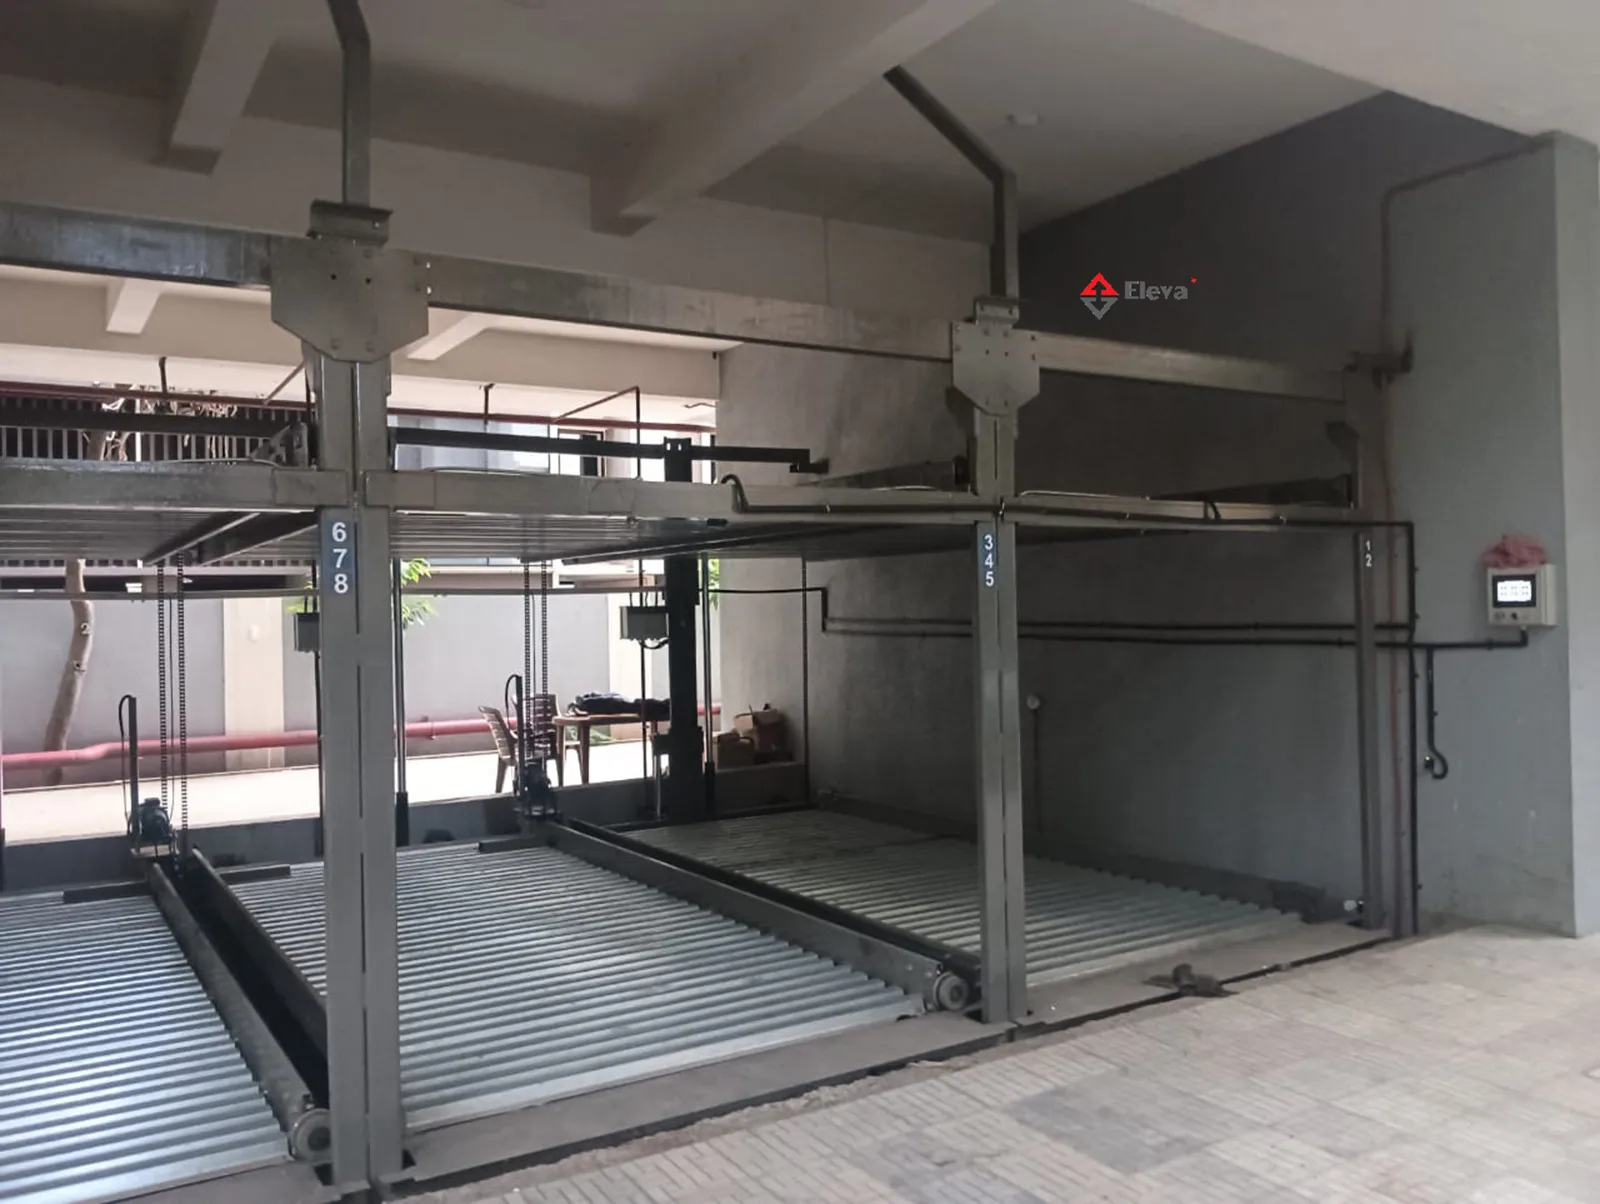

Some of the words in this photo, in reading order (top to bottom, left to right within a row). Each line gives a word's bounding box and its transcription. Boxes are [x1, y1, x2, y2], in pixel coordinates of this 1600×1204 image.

[332, 522, 347, 542] 6
[984, 534, 994, 550] 3
[1365, 540, 1371, 551] 1
[333, 548, 348, 569] 7
[984, 552, 994, 569] 4
[1365, 553, 1373, 568] 2
[334, 573, 349, 594] 8
[985, 571, 995, 587] 5
